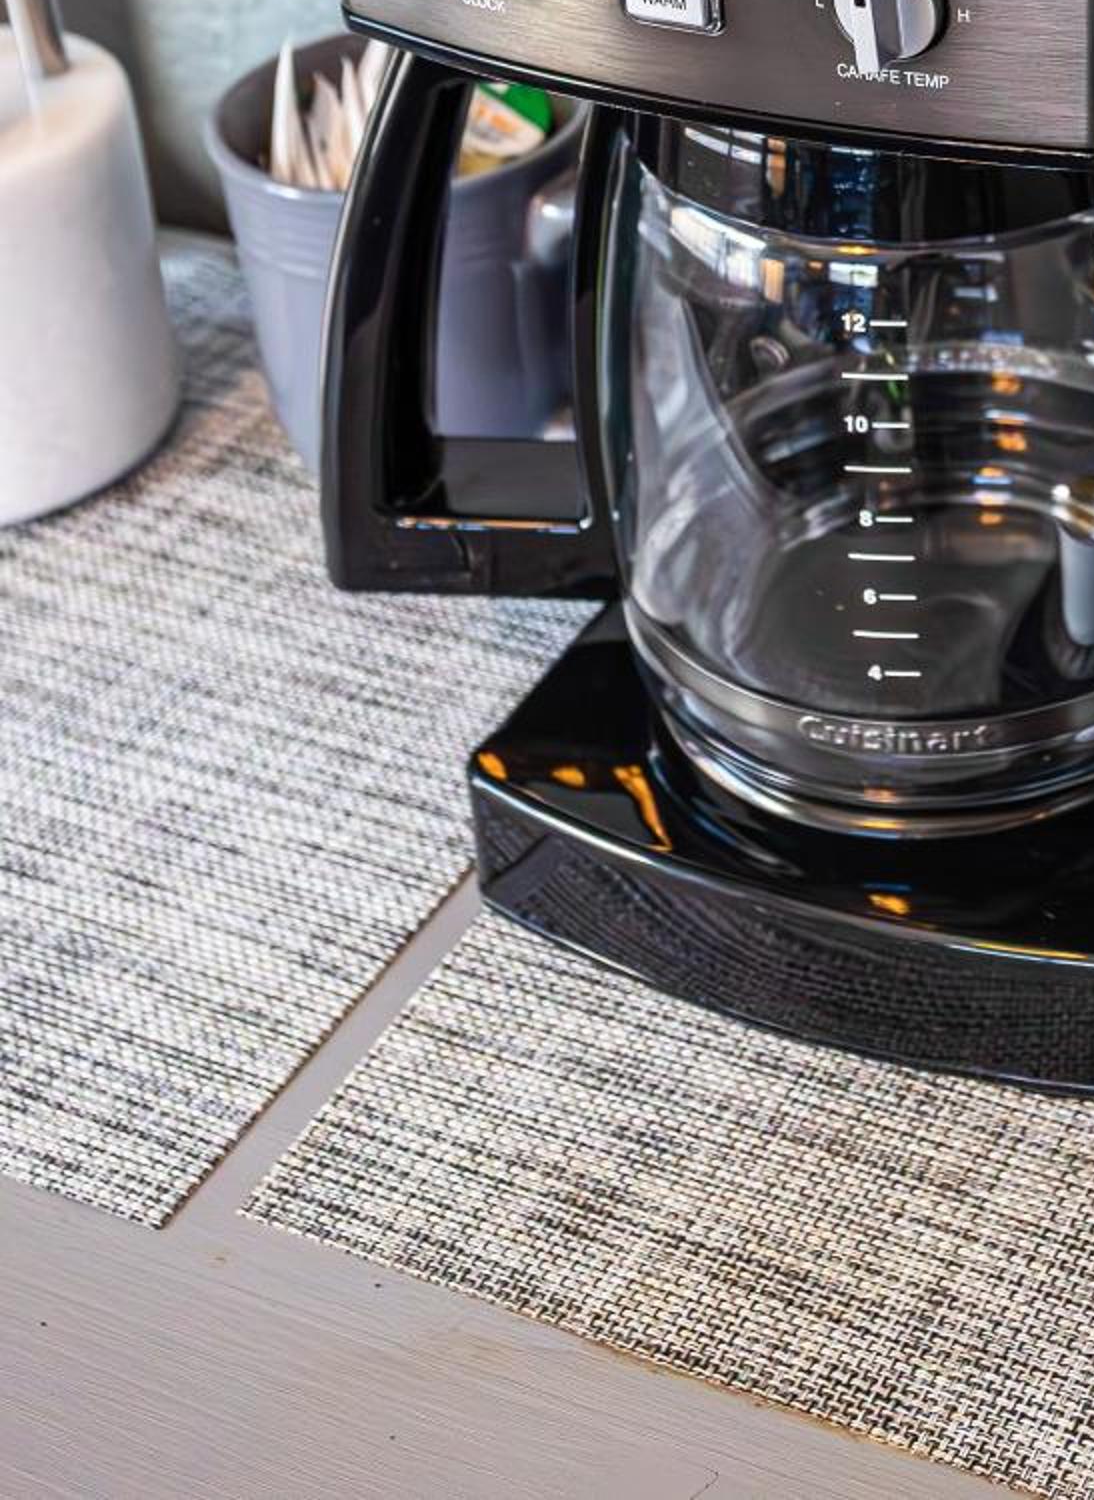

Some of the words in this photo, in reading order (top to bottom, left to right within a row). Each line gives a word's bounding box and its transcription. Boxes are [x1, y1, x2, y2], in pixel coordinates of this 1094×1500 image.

[957, 8, 971, 23] H
[903, 71, 950, 89] TEMP
[841, 313, 866, 333] 12
[844, 415, 869, 433] 10
[859, 510, 873, 527] 8
[863, 588, 877, 605] 6
[867, 666, 883, 681] 4
[799, 715, 988, 751] Cuisinart
